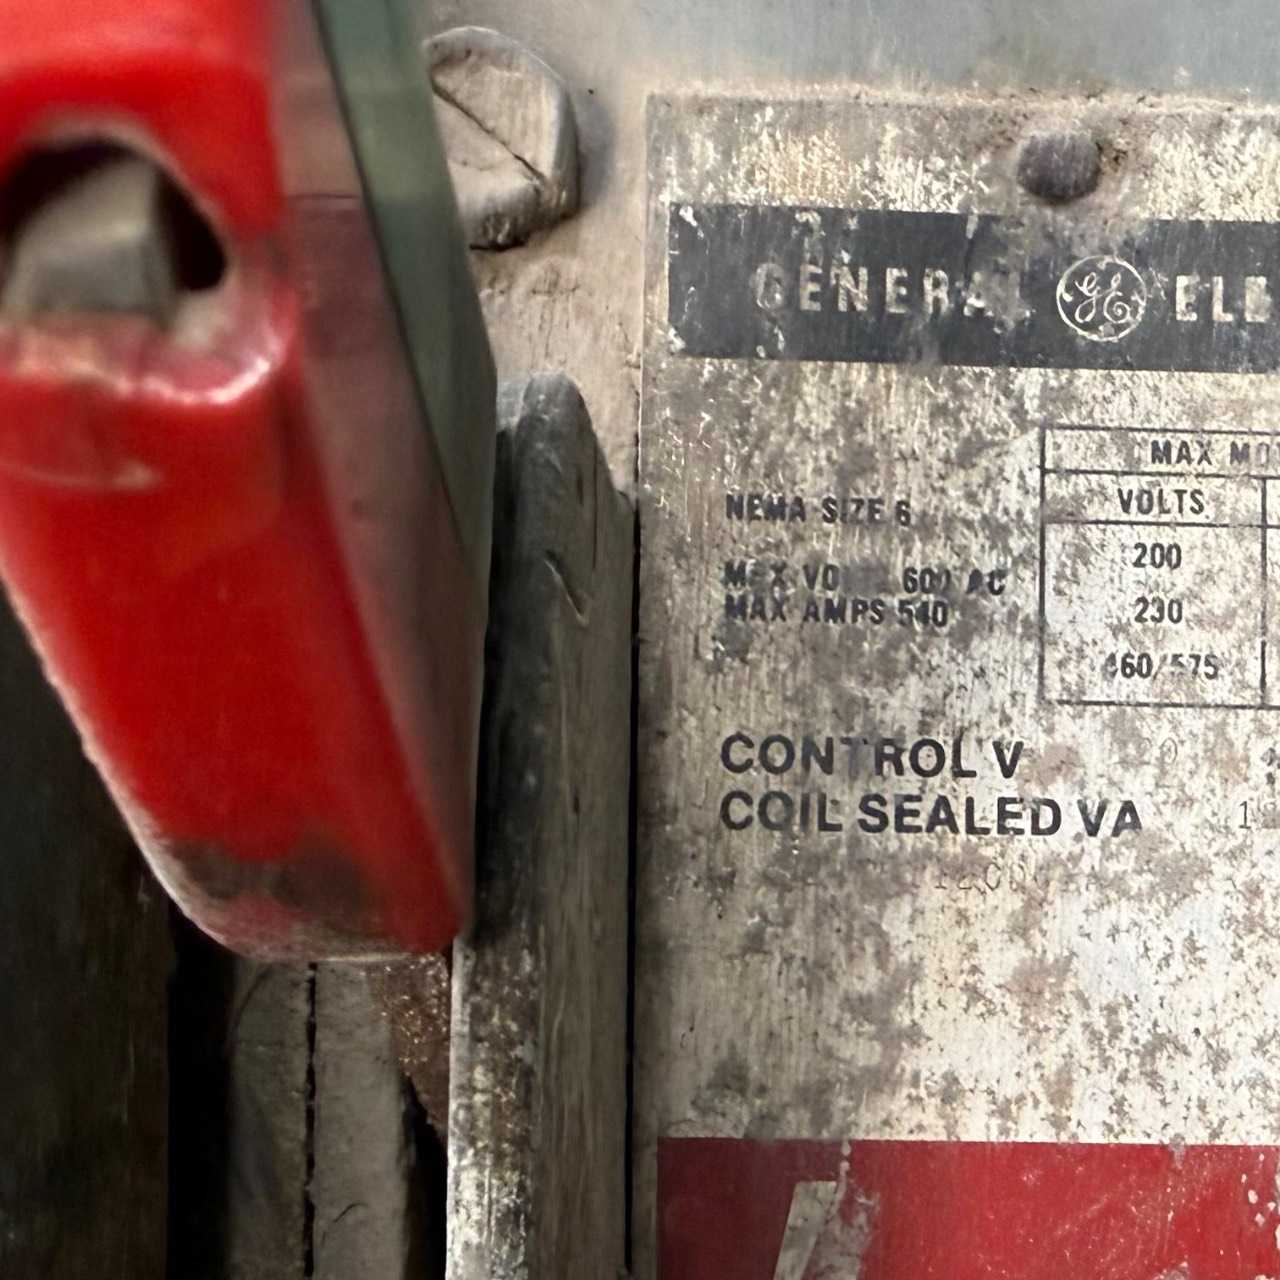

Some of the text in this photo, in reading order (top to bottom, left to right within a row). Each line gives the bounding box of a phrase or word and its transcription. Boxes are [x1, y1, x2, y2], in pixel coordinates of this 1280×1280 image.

[1150, 441, 1212, 466] MAX
[725, 493, 911, 526] NEMA SIZE 6
[1116, 488, 1206, 515] VOLTS
[1132, 541, 1182, 569] 200
[966, 568, 1010, 595] AC
[725, 594, 786, 622] MAX
[803, 598, 885, 625] AMPS
[1134, 597, 1183, 624] 230
[721, 731, 976, 779] CONTROL
[992, 741, 1024, 779] V
[721, 790, 843, 832] COIL
[857, 799, 1062, 837] SEALED
[1076, 800, 1143, 838] VA
